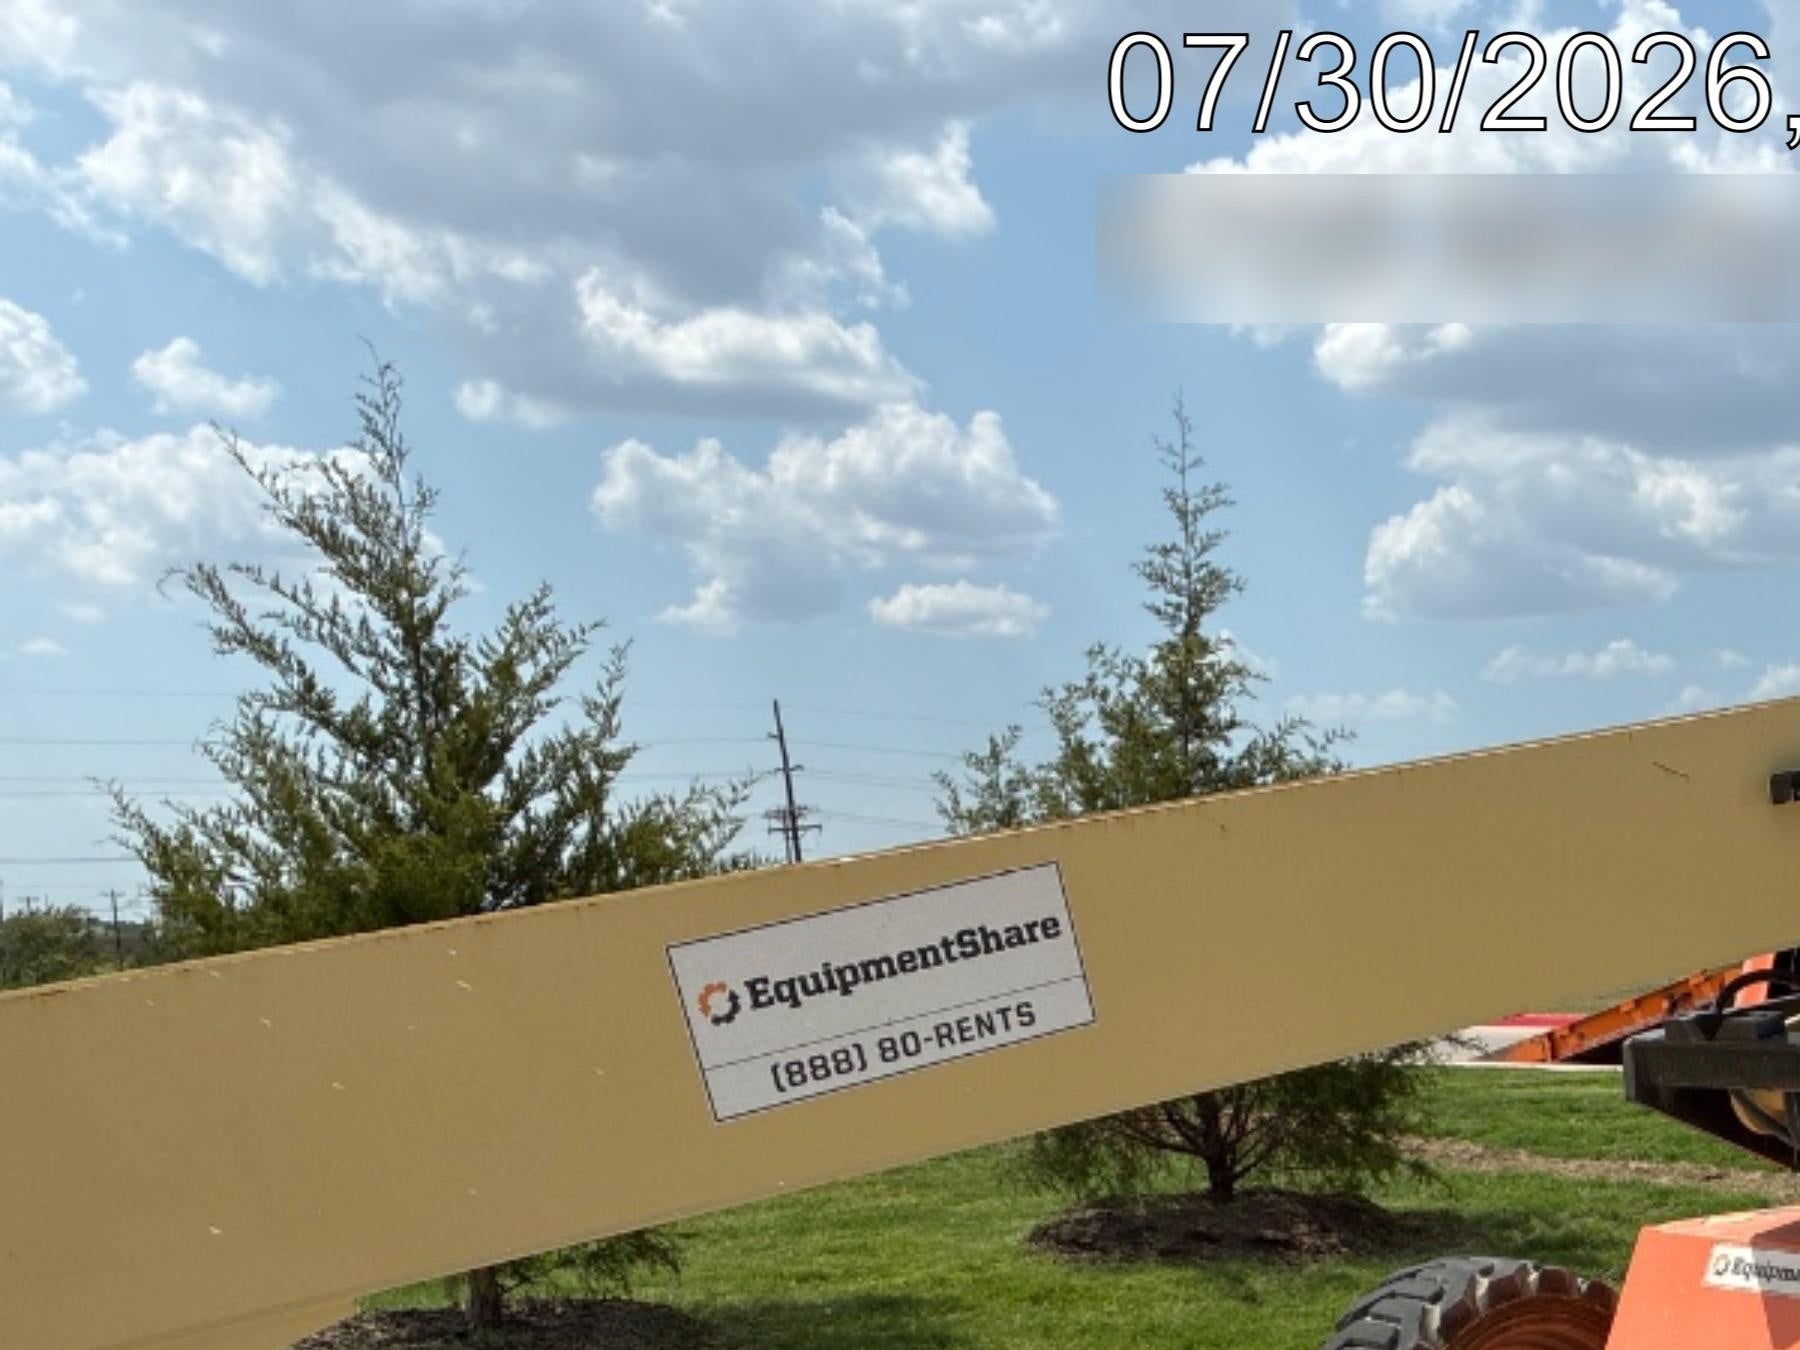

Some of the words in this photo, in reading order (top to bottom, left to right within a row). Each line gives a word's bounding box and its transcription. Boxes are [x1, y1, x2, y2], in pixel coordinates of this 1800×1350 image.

[744, 916, 1061, 1009] EquipmentShare
[770, 1042, 868, 1092] (888)
[879, 1001, 1036, 1062] 80-RENTS
